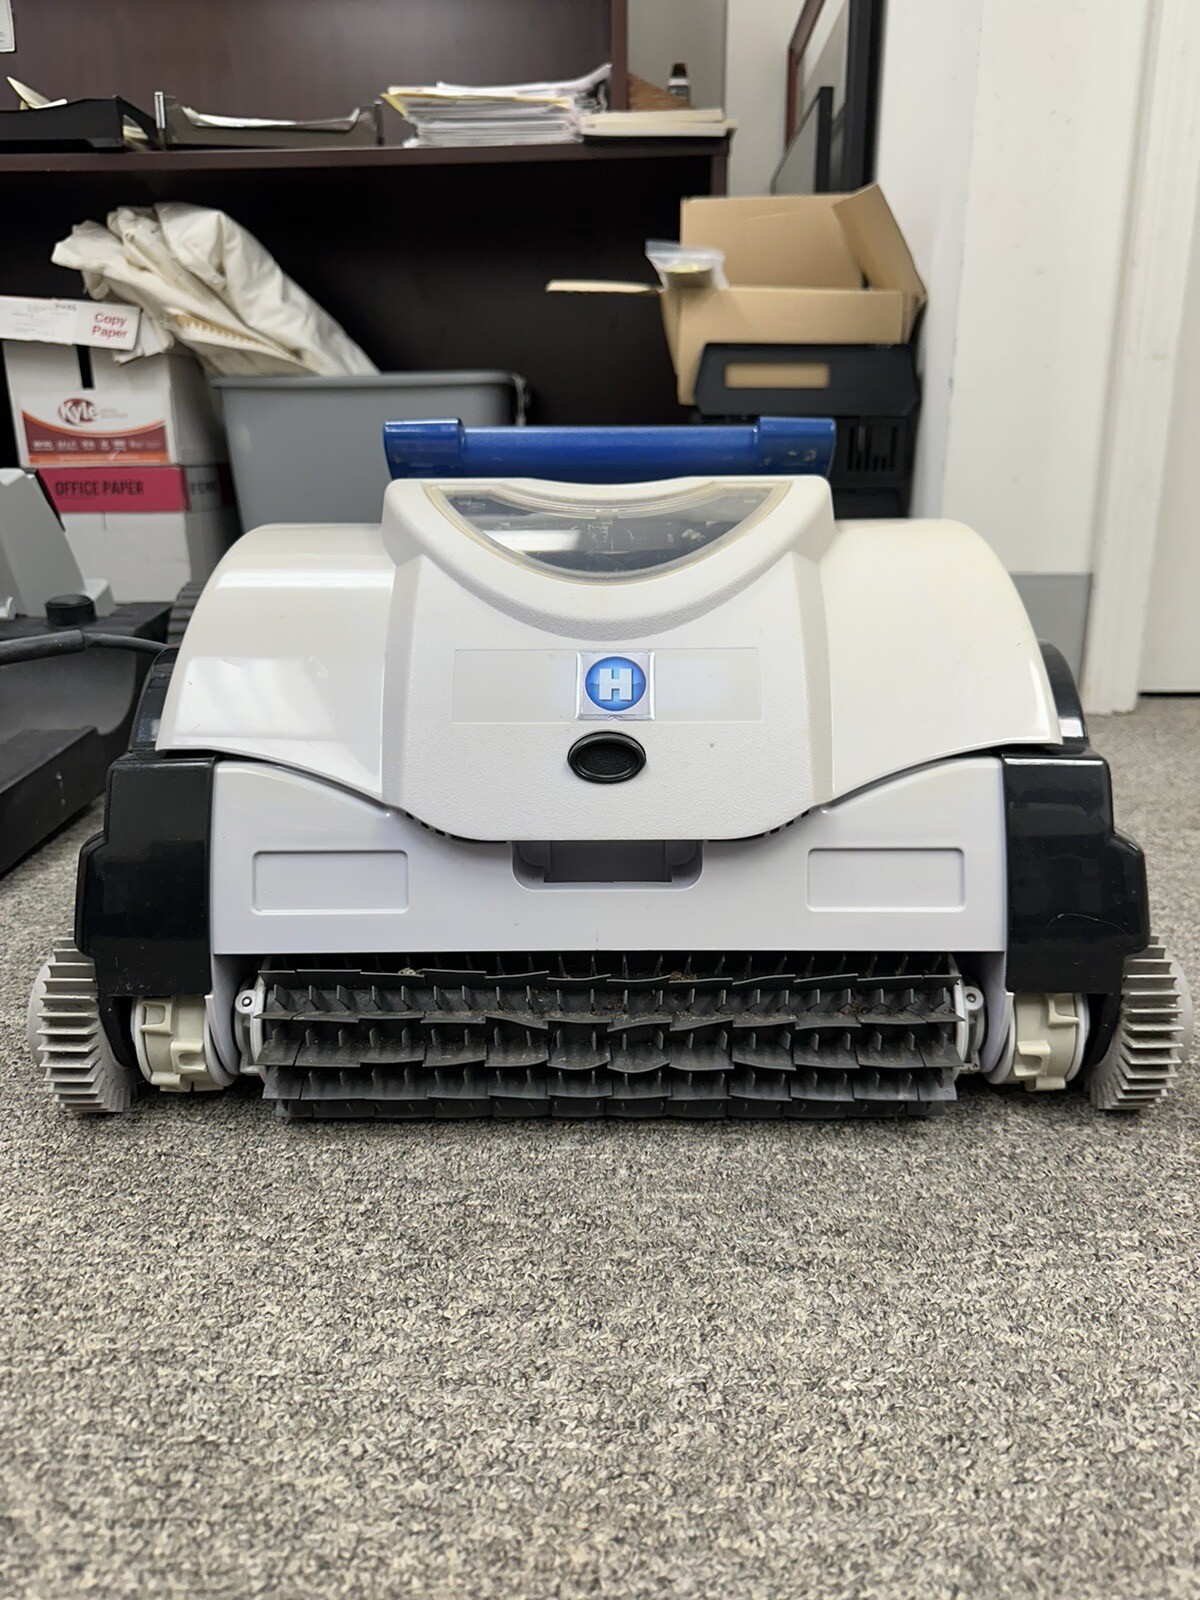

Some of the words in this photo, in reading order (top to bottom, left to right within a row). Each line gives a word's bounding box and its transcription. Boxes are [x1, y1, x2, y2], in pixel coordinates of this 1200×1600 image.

[94, 312, 127, 327] Copy
[92, 324, 128, 339] Paper
[54, 481, 99, 496] OFFICE
[102, 481, 144, 496] PAPER
[599, 668, 632, 701] H
